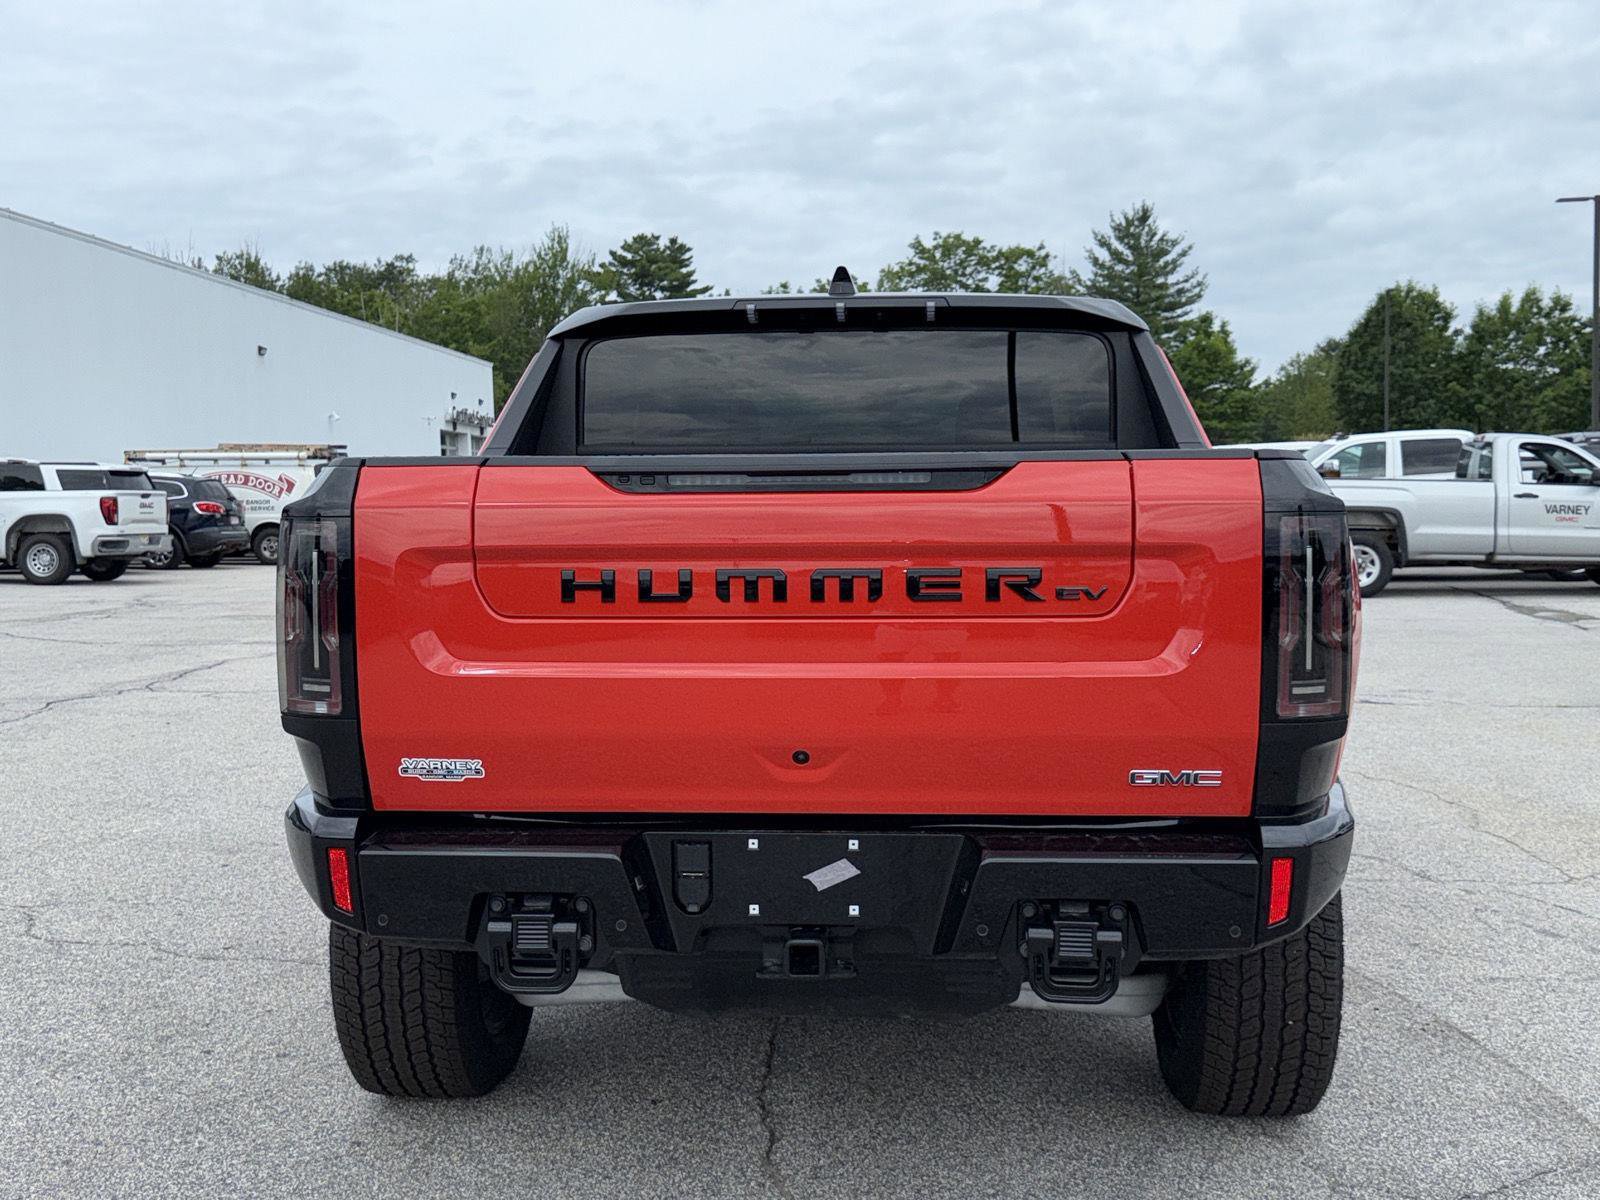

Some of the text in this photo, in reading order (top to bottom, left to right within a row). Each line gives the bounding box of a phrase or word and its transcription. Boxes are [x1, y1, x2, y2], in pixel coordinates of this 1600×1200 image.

[248, 475, 281, 496] DOOR
[1544, 504, 1591, 515] VARNEY
[560, 568, 1108, 602] HUMMER EV
[402, 759, 481, 769] VARNEY
[1129, 769, 1223, 787] GMC
